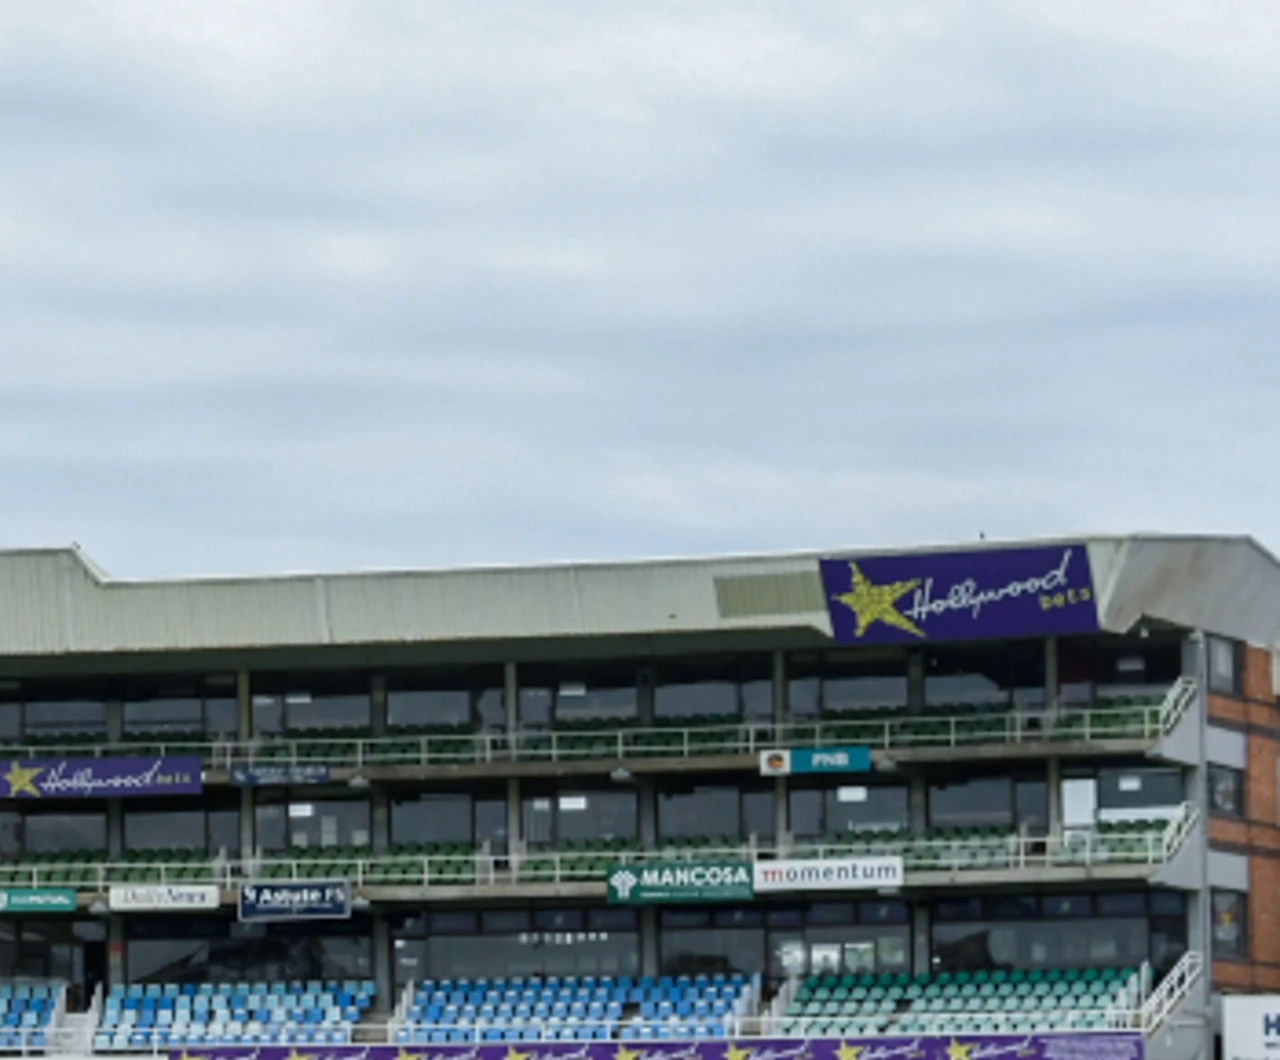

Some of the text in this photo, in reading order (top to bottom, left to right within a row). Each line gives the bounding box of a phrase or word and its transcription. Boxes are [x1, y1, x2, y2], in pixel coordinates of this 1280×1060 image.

[904, 548, 1073, 620] Hollywood
[1040, 588, 1091, 611] bets
[40, 759, 162, 798] Hollywood
[641, 865, 751, 887] MANCOSA
[761, 861, 899, 883] momentum
